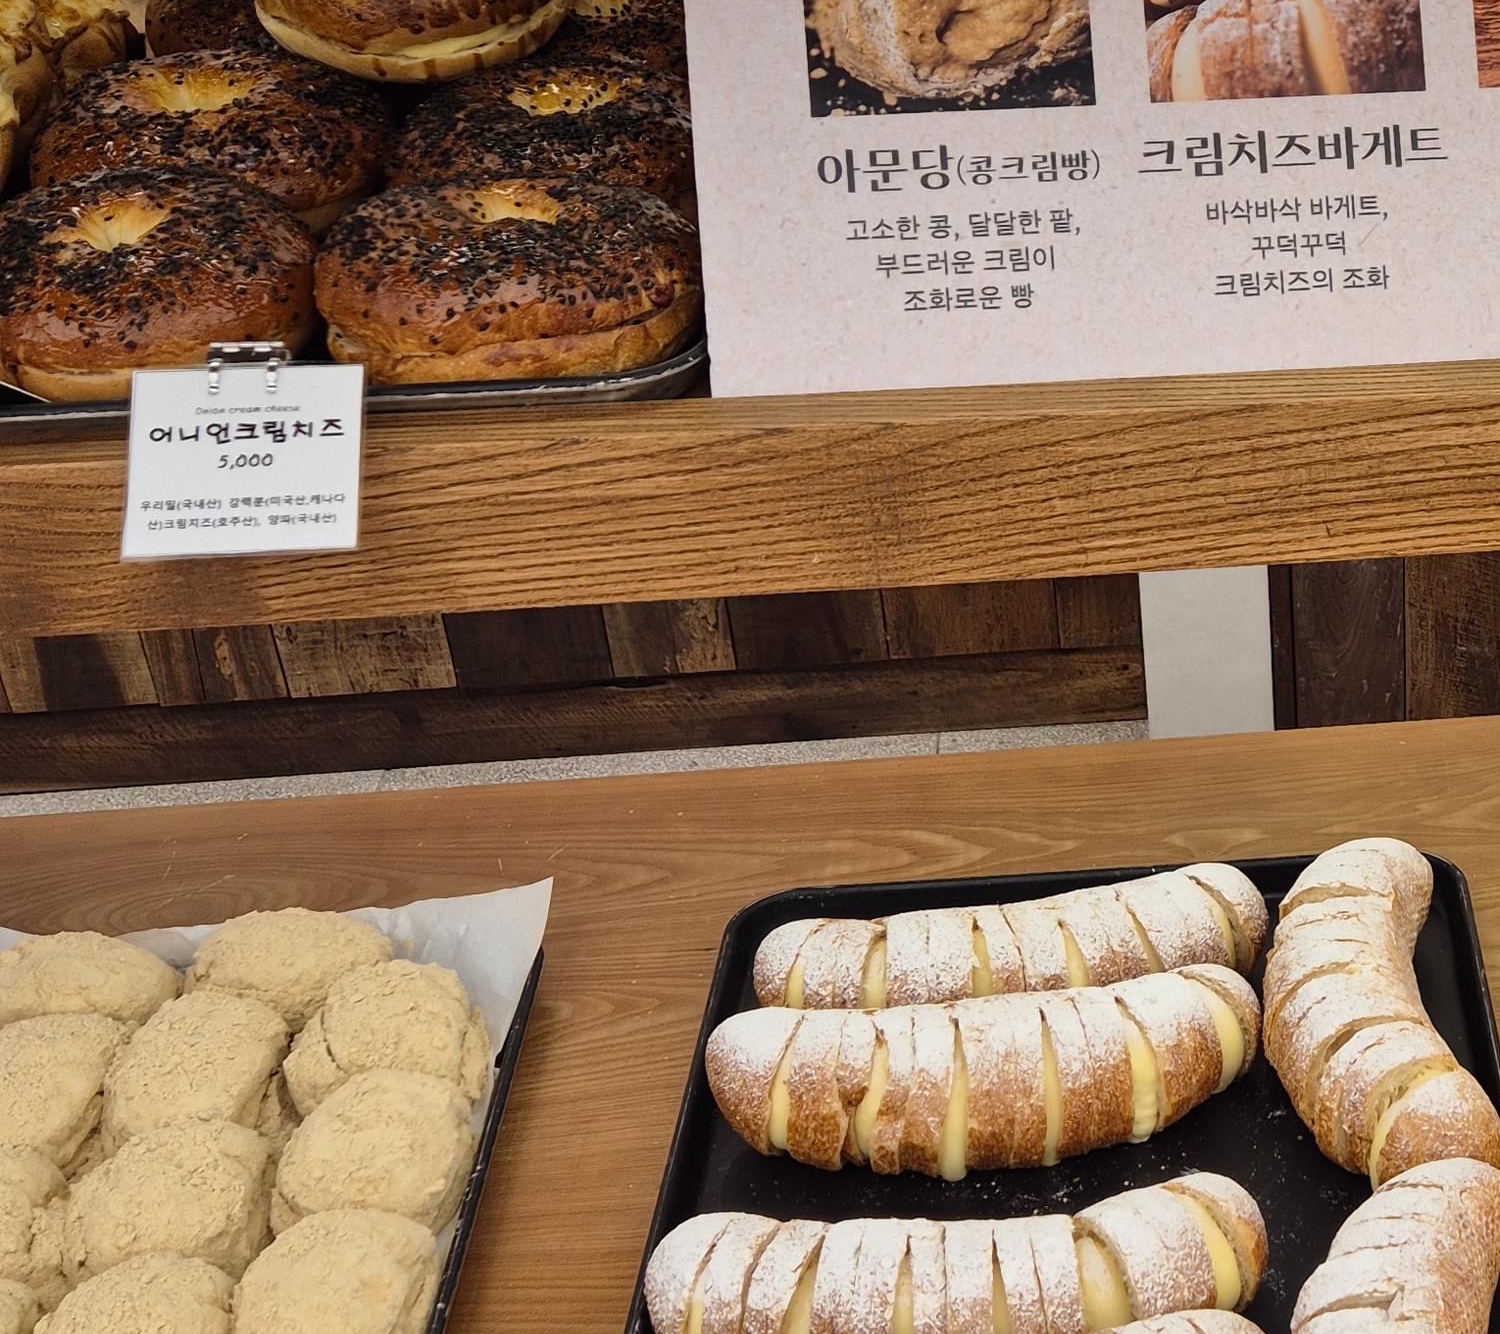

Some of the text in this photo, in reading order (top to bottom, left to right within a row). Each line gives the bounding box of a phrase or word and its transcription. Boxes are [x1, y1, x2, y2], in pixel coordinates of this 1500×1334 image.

[1137, 123, 1449, 178] 크림치즈바게트
[816, 144, 1101, 194] 아문당(콩크림빵)
[846, 207, 1082, 242] 고소한 콩, 달달한 팥,
[1205, 193, 1389, 226] 바삭바삭 바게트,
[875, 244, 1056, 279] 부드러운 크림이
[1251, 230, 1347, 260] 꾸덕꾸덕
[903, 282, 1035, 313] 조화로운 빵
[1214, 264, 1390, 298] 크림치즈의 조화
[149, 418, 345, 445] 어니언크림치즈
[217, 452, 274, 471] 5,000
